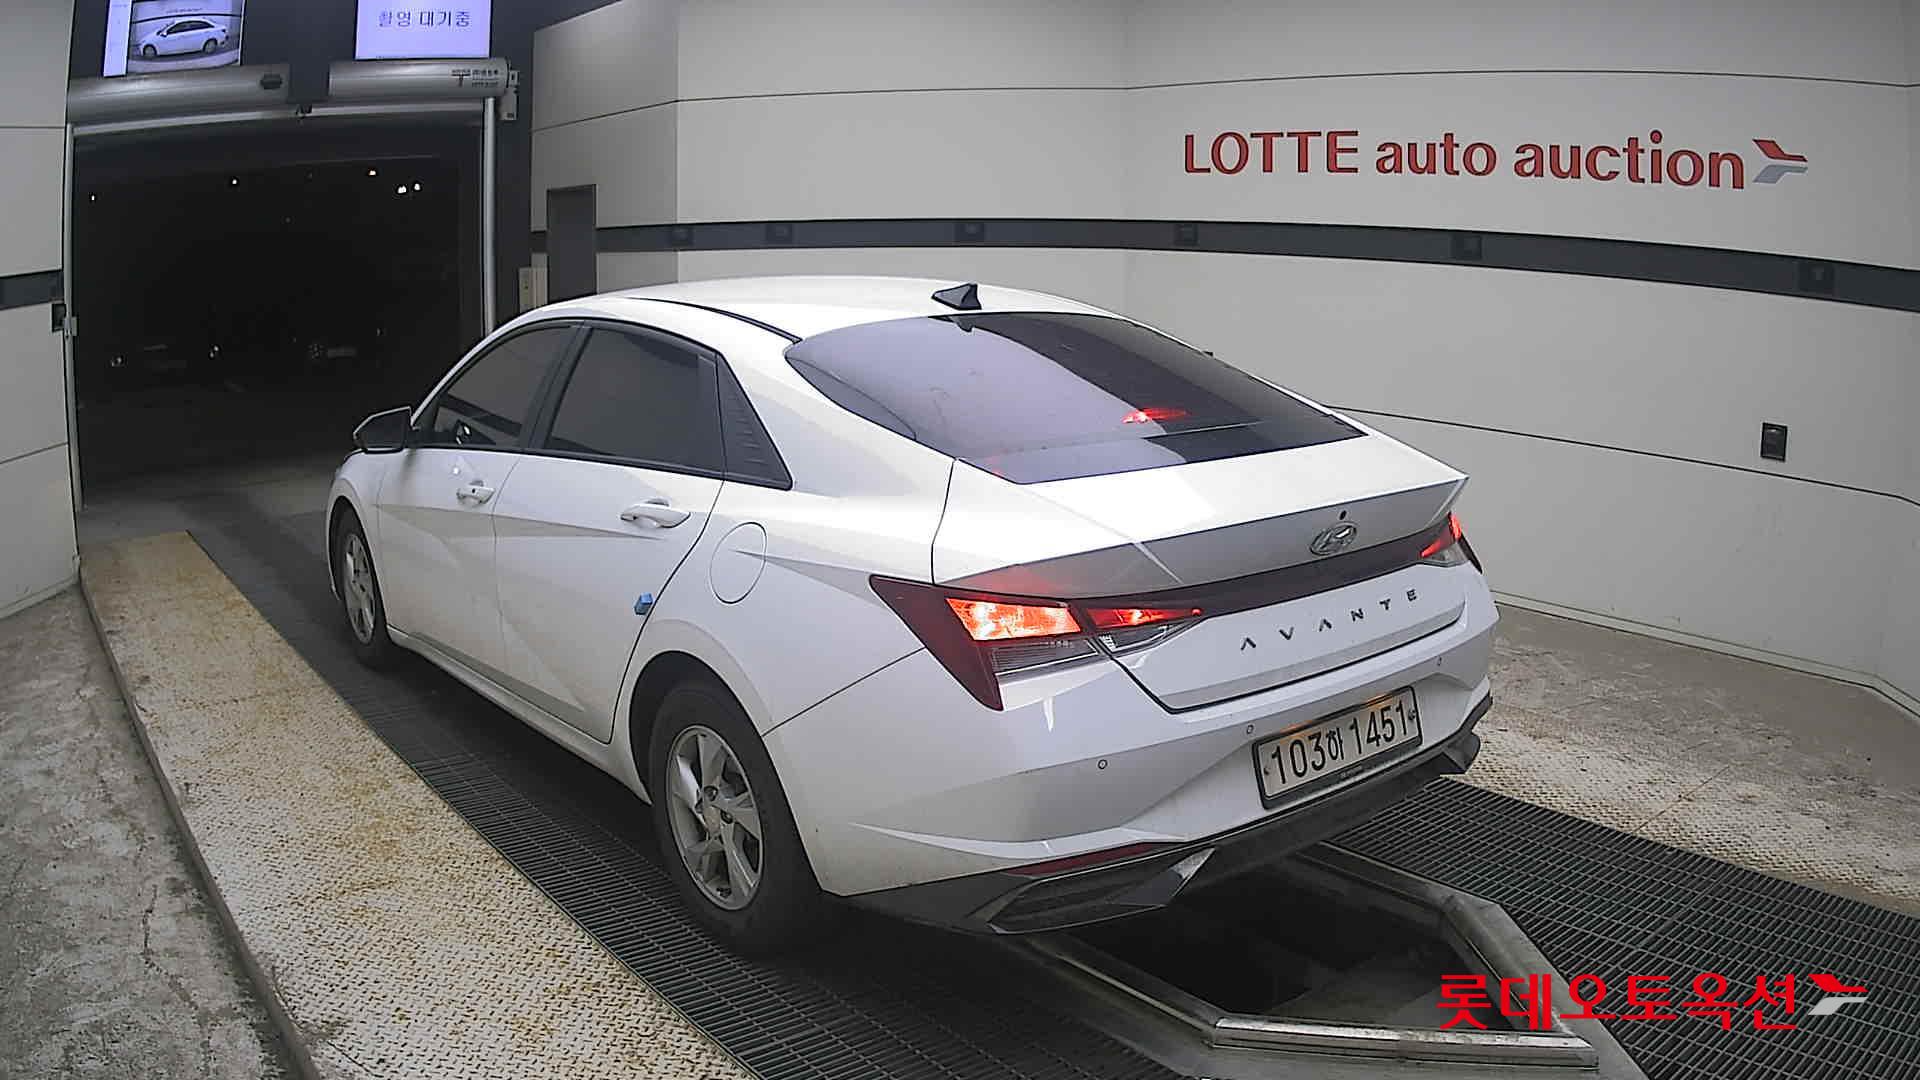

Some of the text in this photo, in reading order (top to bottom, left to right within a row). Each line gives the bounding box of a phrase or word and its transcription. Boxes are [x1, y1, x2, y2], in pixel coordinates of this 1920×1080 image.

[419, 10, 471, 28] 대기중
[1184, 129, 1745, 189] LOTTE auto auction
[1240, 588, 1418, 651] AVANTE
[1271, 699, 1408, 785] 103하 1451
